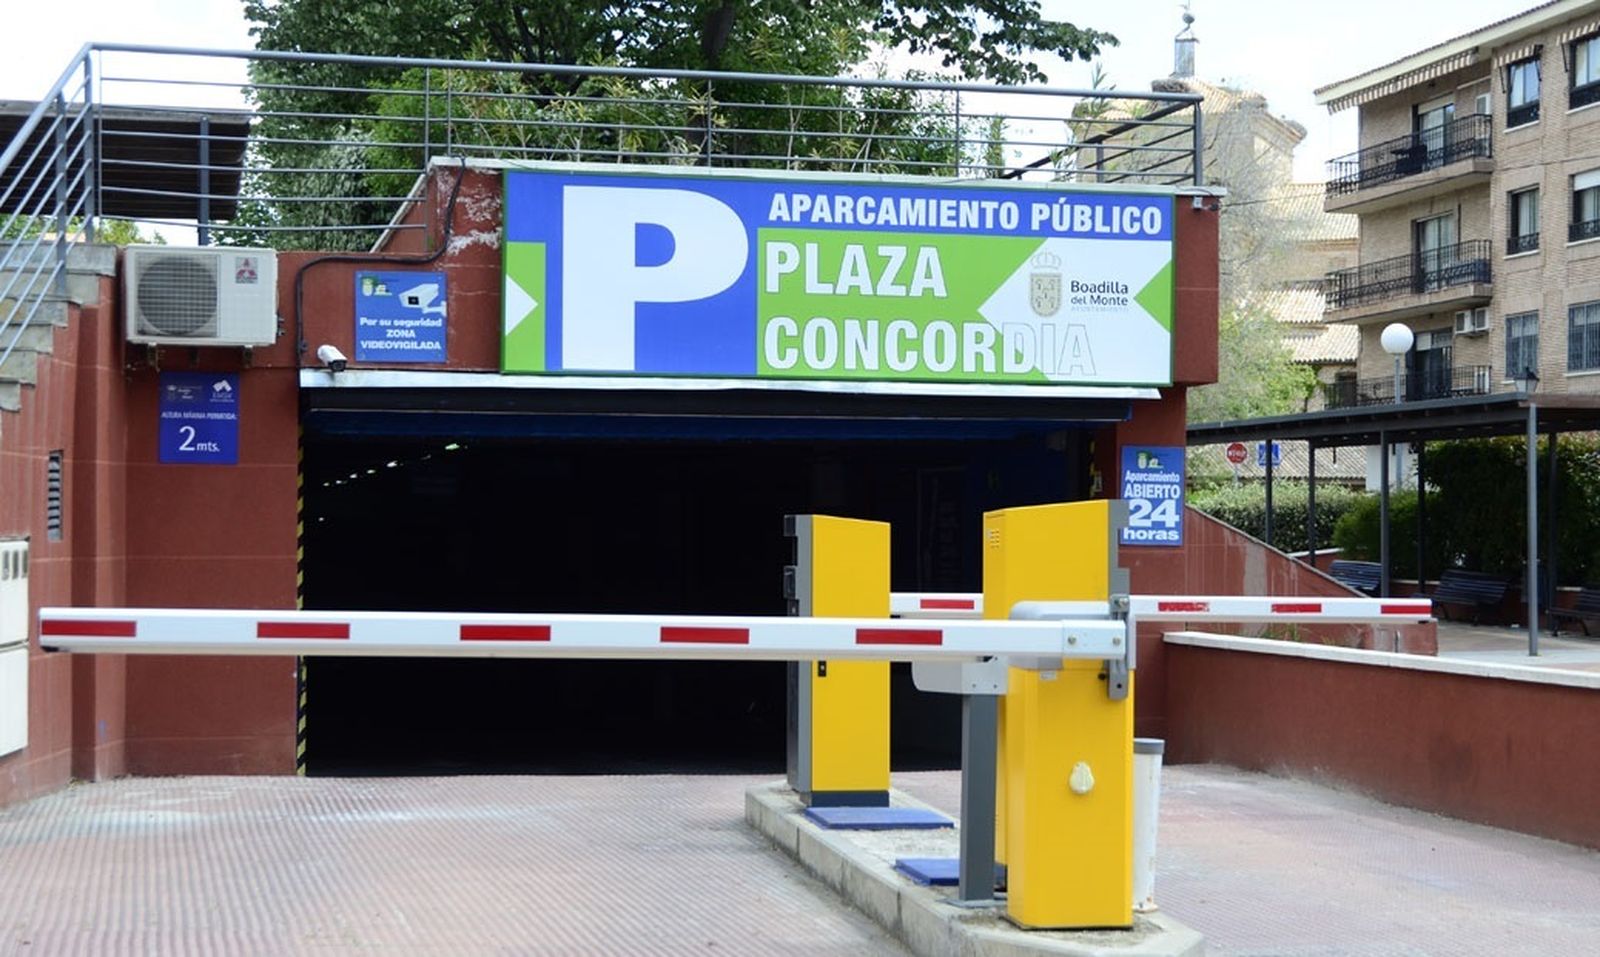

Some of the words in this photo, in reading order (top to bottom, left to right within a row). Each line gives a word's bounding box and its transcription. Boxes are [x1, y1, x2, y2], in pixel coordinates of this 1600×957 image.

[768, 192, 1019, 231] APARCAMIENTO
[1030, 196, 1163, 236] PÚBLICO
[765, 240, 948, 298] PLAZA
[562, 185, 749, 372] P
[1070, 280, 1129, 295] Boadilla
[1070, 295, 1087, 306] del
[1089, 295, 1129, 307] Monte
[360, 317, 377, 326] Por
[393, 317, 443, 328] seguridad
[386, 329, 416, 338] ZONA
[360, 340, 441, 350] VIDEOVIGILADA
[763, 316, 1098, 377] CONCORDIA
[179, 425, 195, 451] 2
[197, 441, 220, 452] mts.
[1124, 470, 1181, 483] Aparcamiento
[1124, 484, 1181, 498] ABIERTO
[1128, 498, 1180, 528] 24
[1123, 527, 1180, 540] horas
